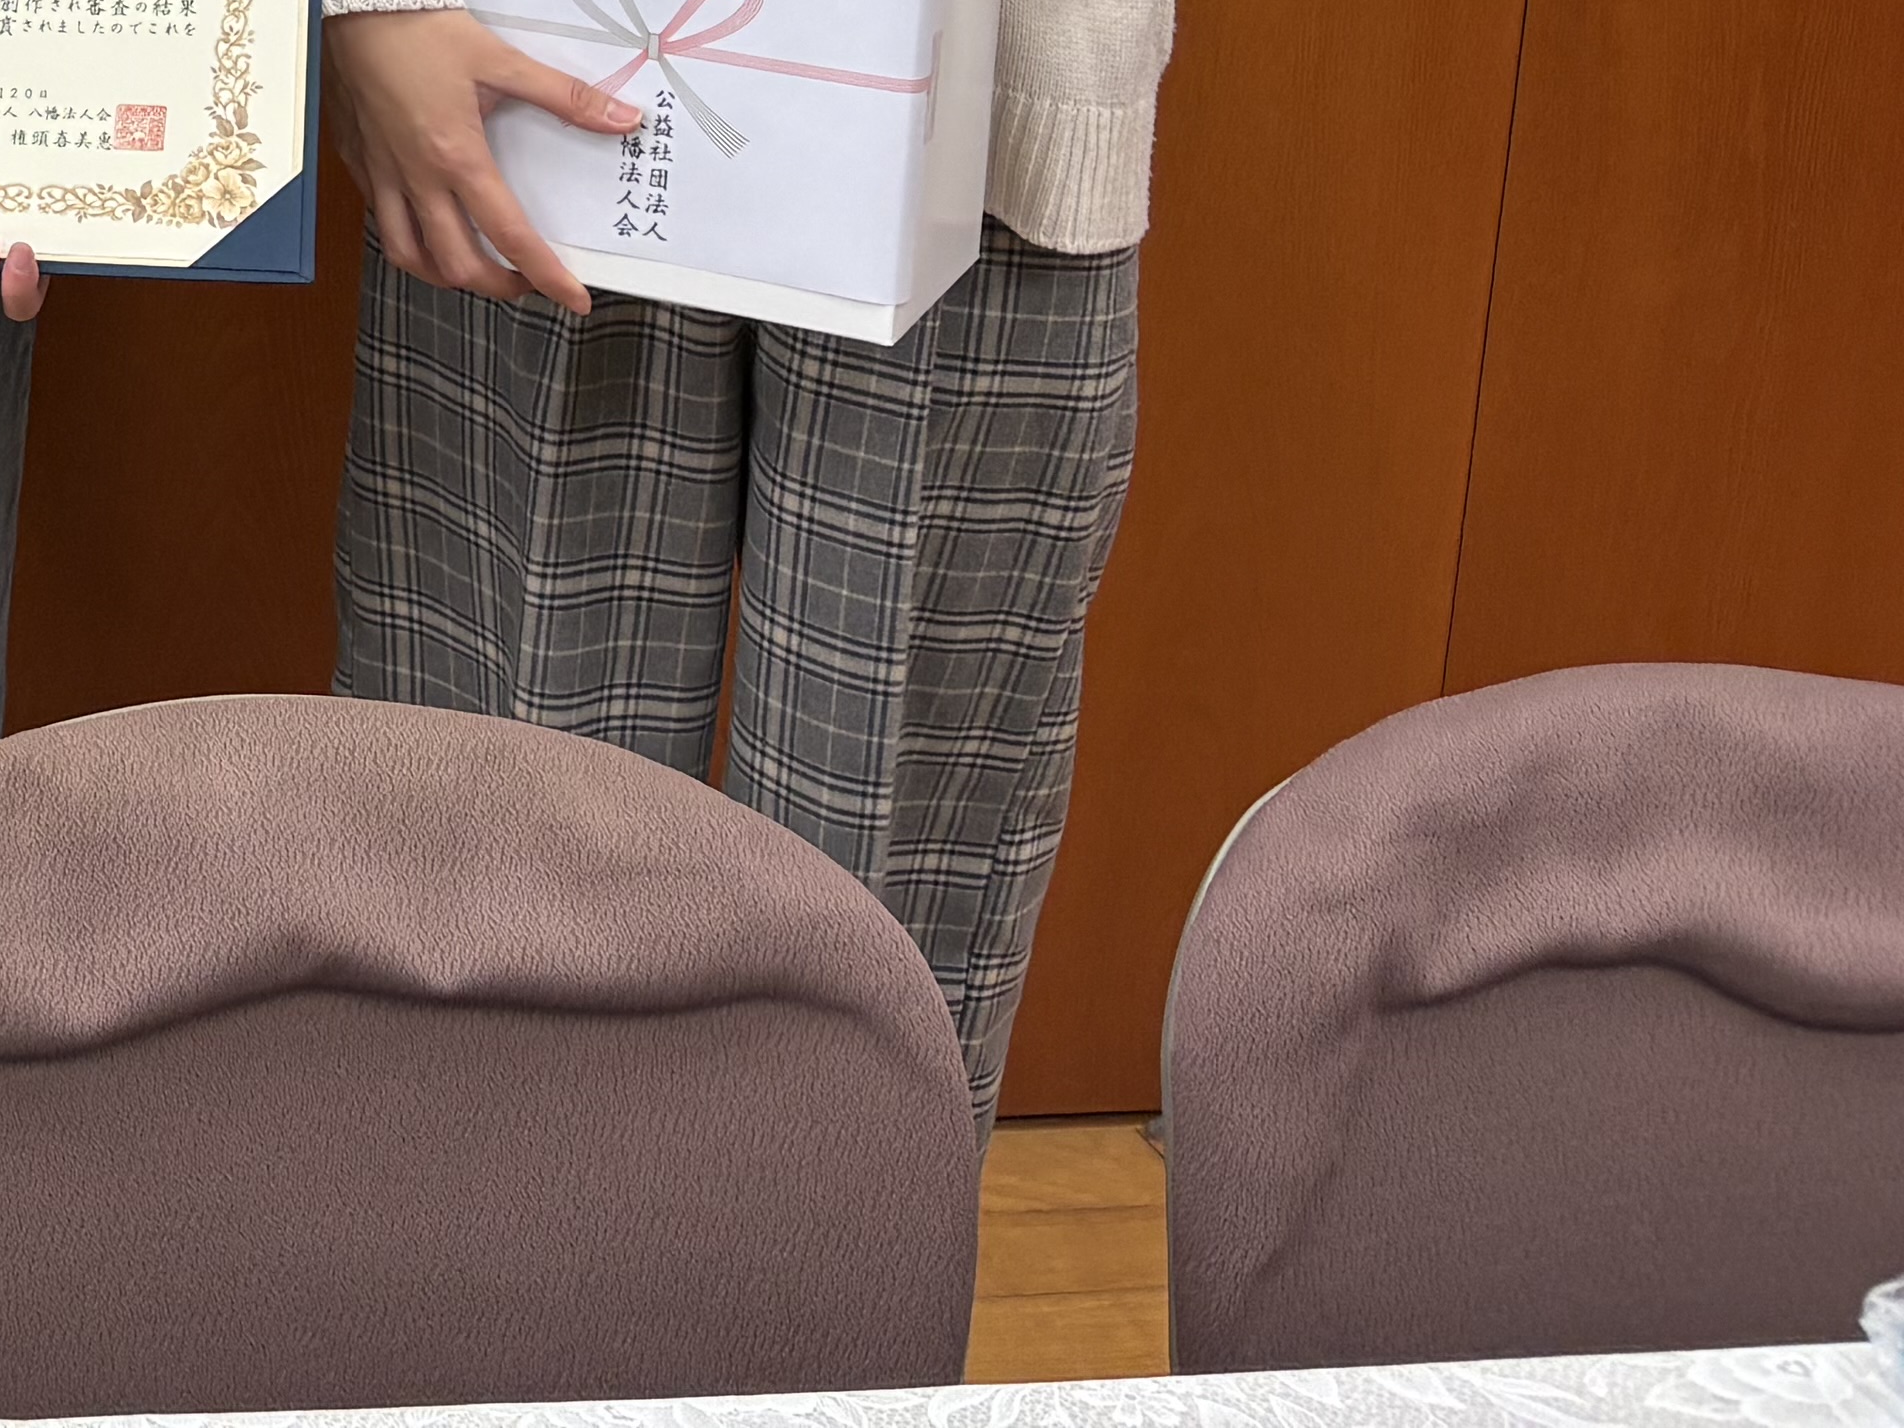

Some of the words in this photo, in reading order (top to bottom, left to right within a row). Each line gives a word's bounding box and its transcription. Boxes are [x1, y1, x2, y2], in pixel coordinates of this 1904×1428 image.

[28, 106, 113, 123] 八幡法人会
[642, 88, 676, 243] 公益社団法人
[611, 117, 648, 240] 幡法人会
